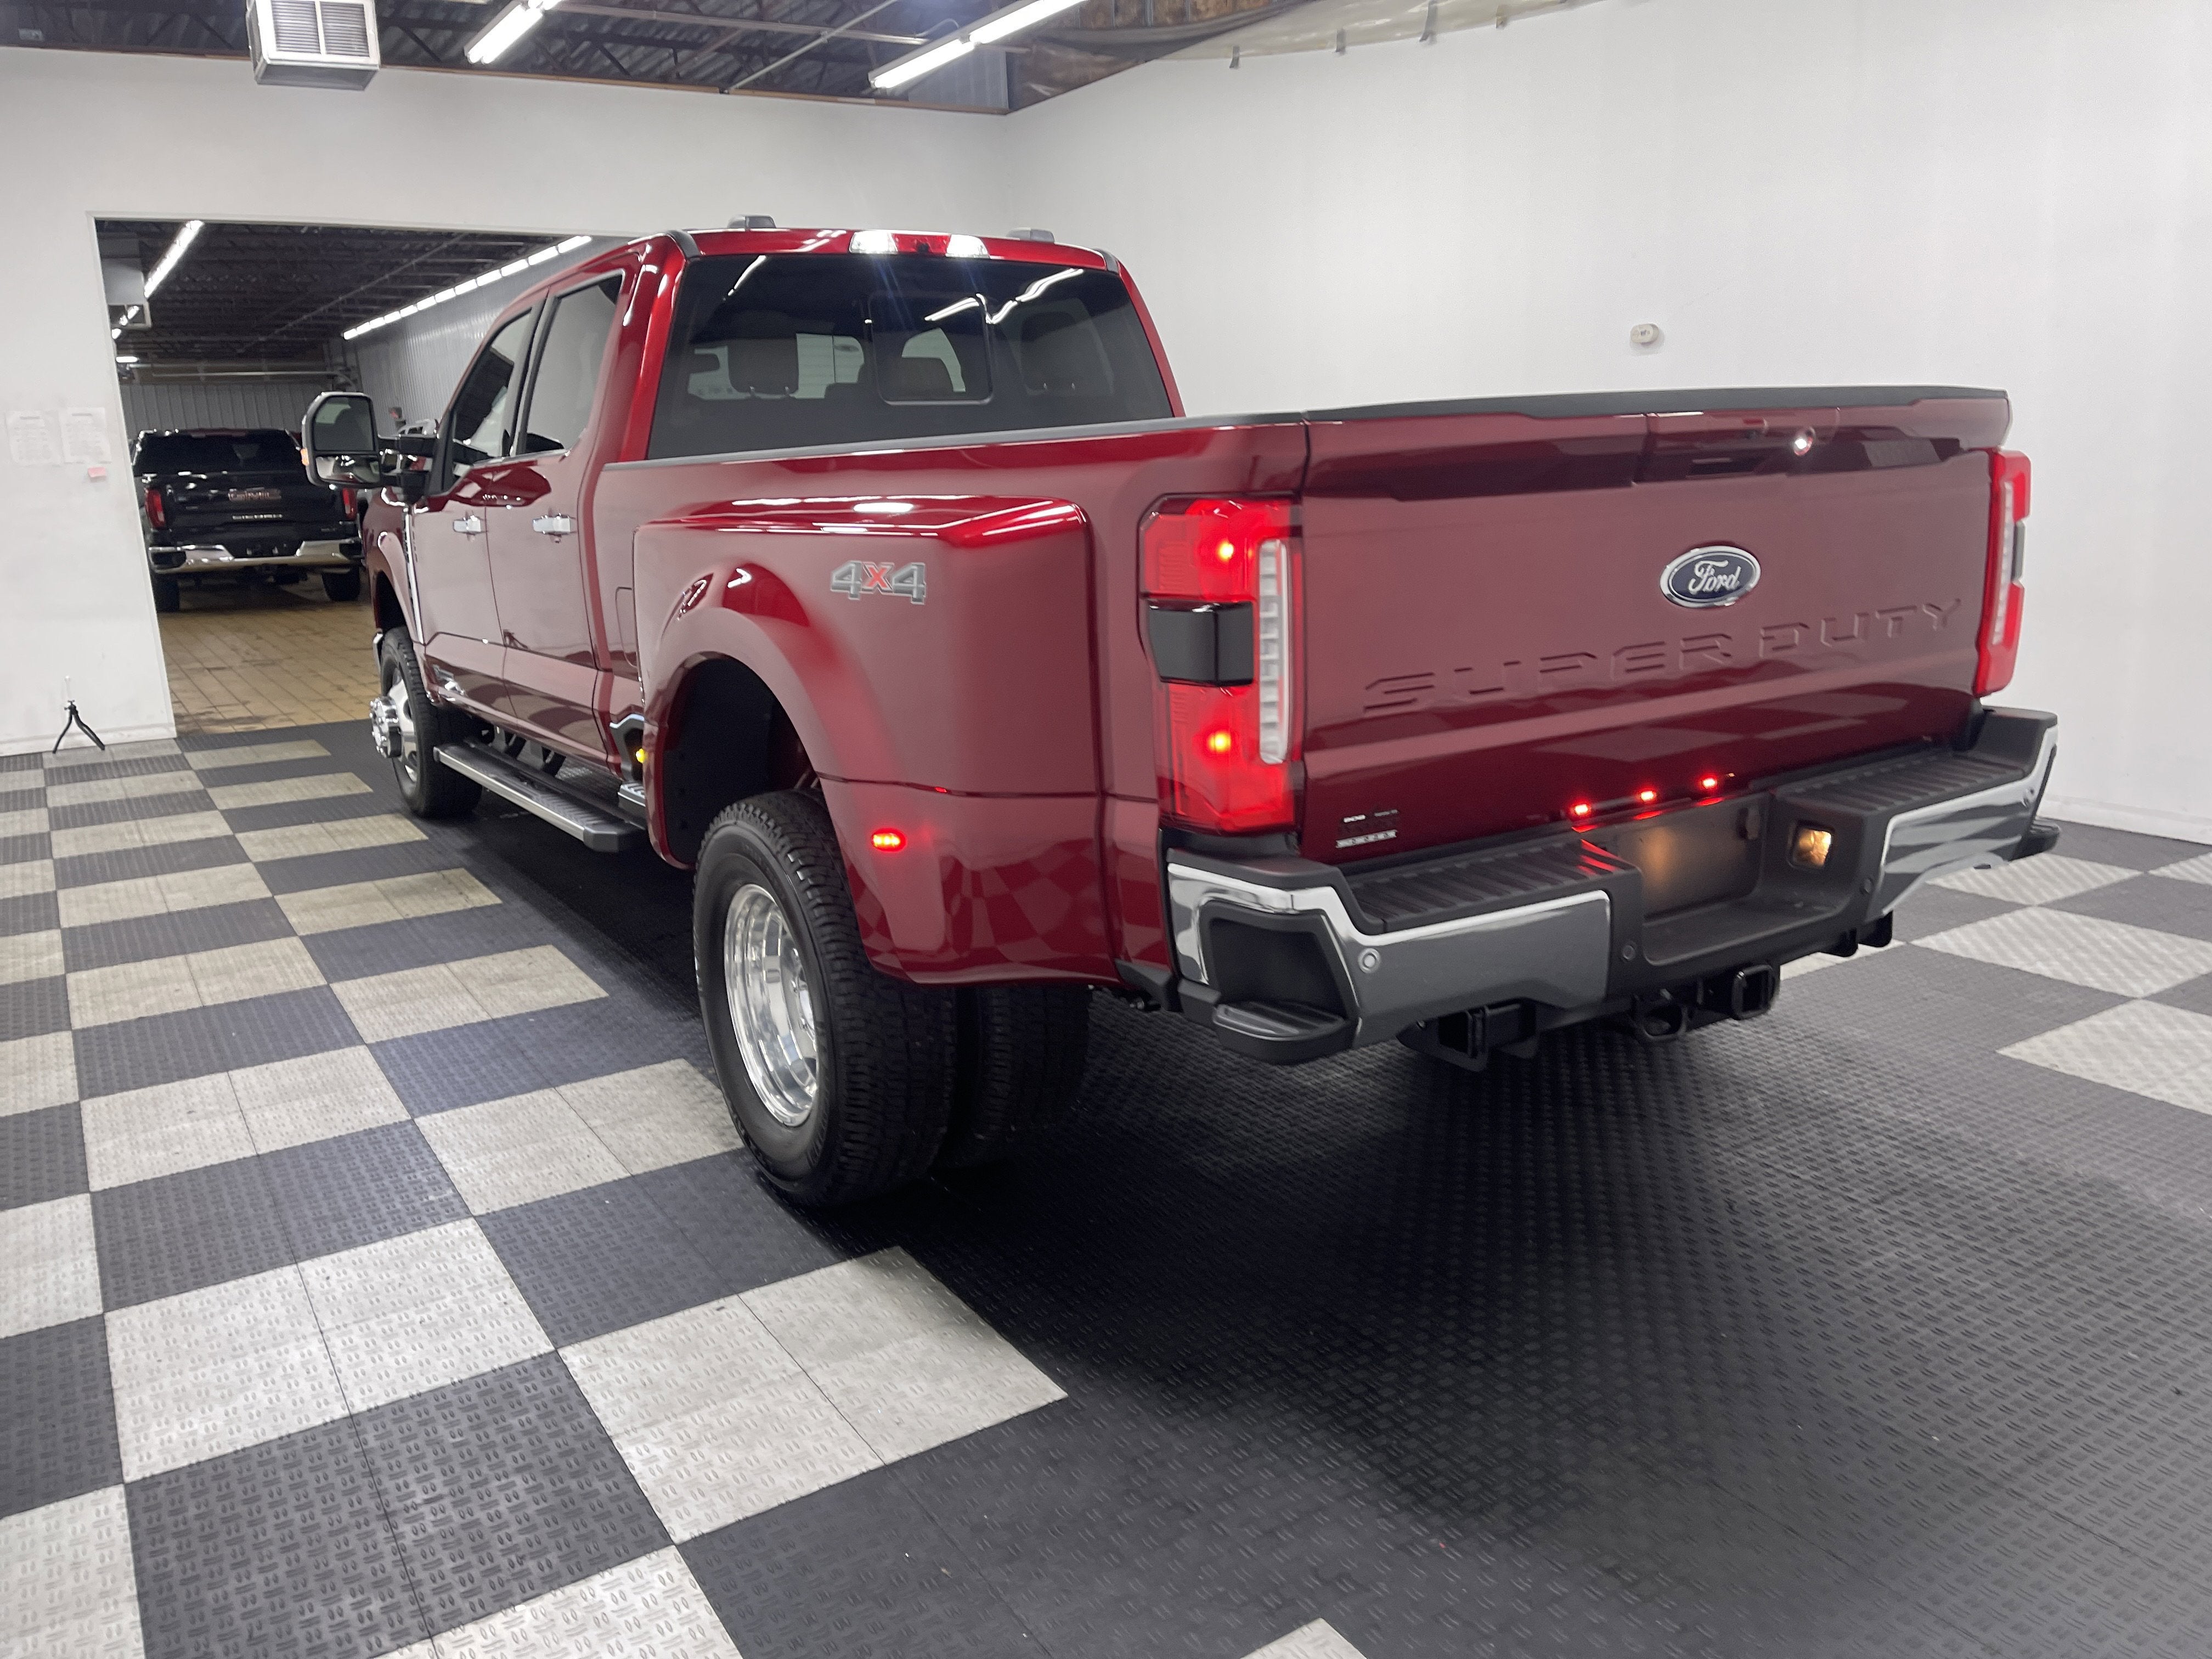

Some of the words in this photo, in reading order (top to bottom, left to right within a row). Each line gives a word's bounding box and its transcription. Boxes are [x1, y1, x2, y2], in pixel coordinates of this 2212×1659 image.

[1688, 560, 1741, 595] Ford
[1364, 633, 1734, 713] SUPER
[1758, 598, 1961, 658] DUTY
